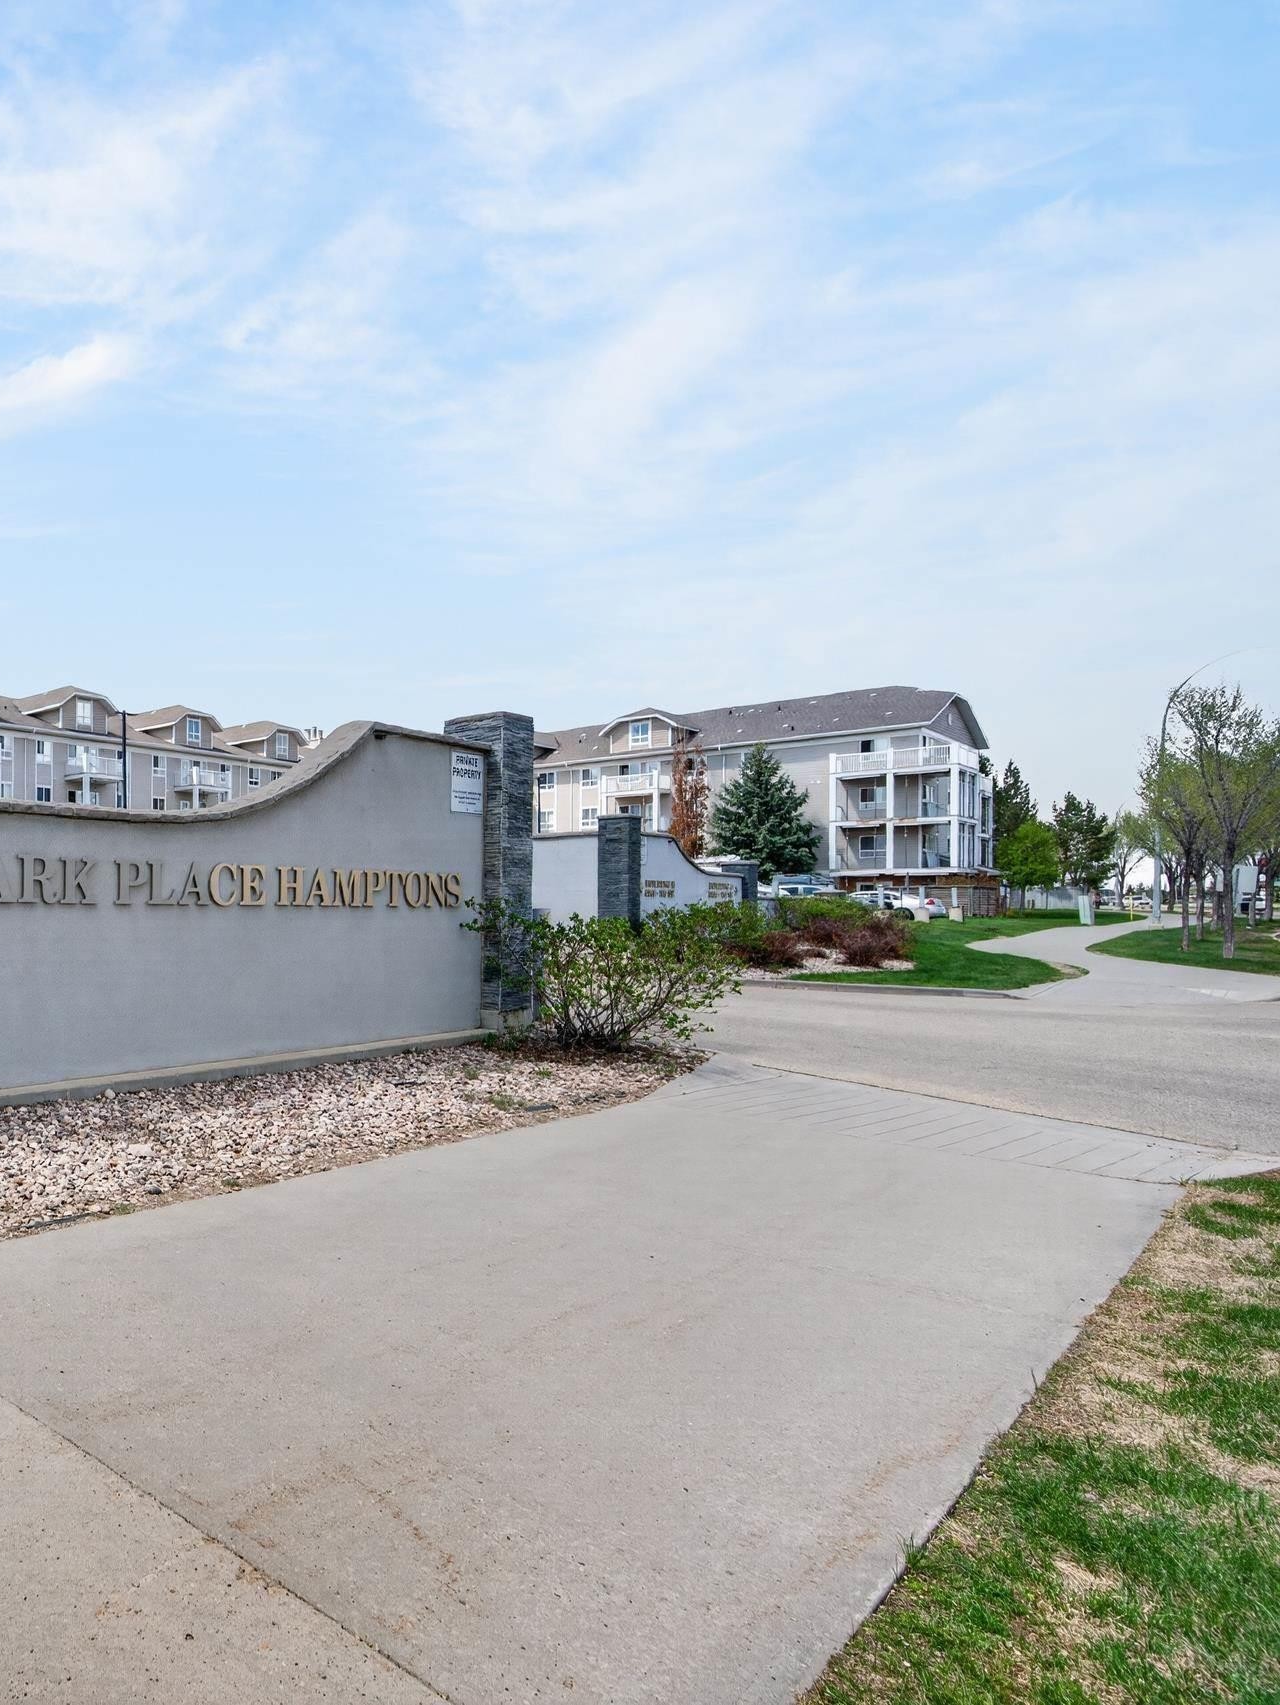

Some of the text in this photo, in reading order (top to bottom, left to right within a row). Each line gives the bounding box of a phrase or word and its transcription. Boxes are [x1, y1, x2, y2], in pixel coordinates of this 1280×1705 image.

[456, 755, 478, 767] PRIVATE
[452, 766, 480, 779] PROPERTY
[113, 858, 267, 907] PLACE
[275, 865, 462, 908] HAMPTONS
